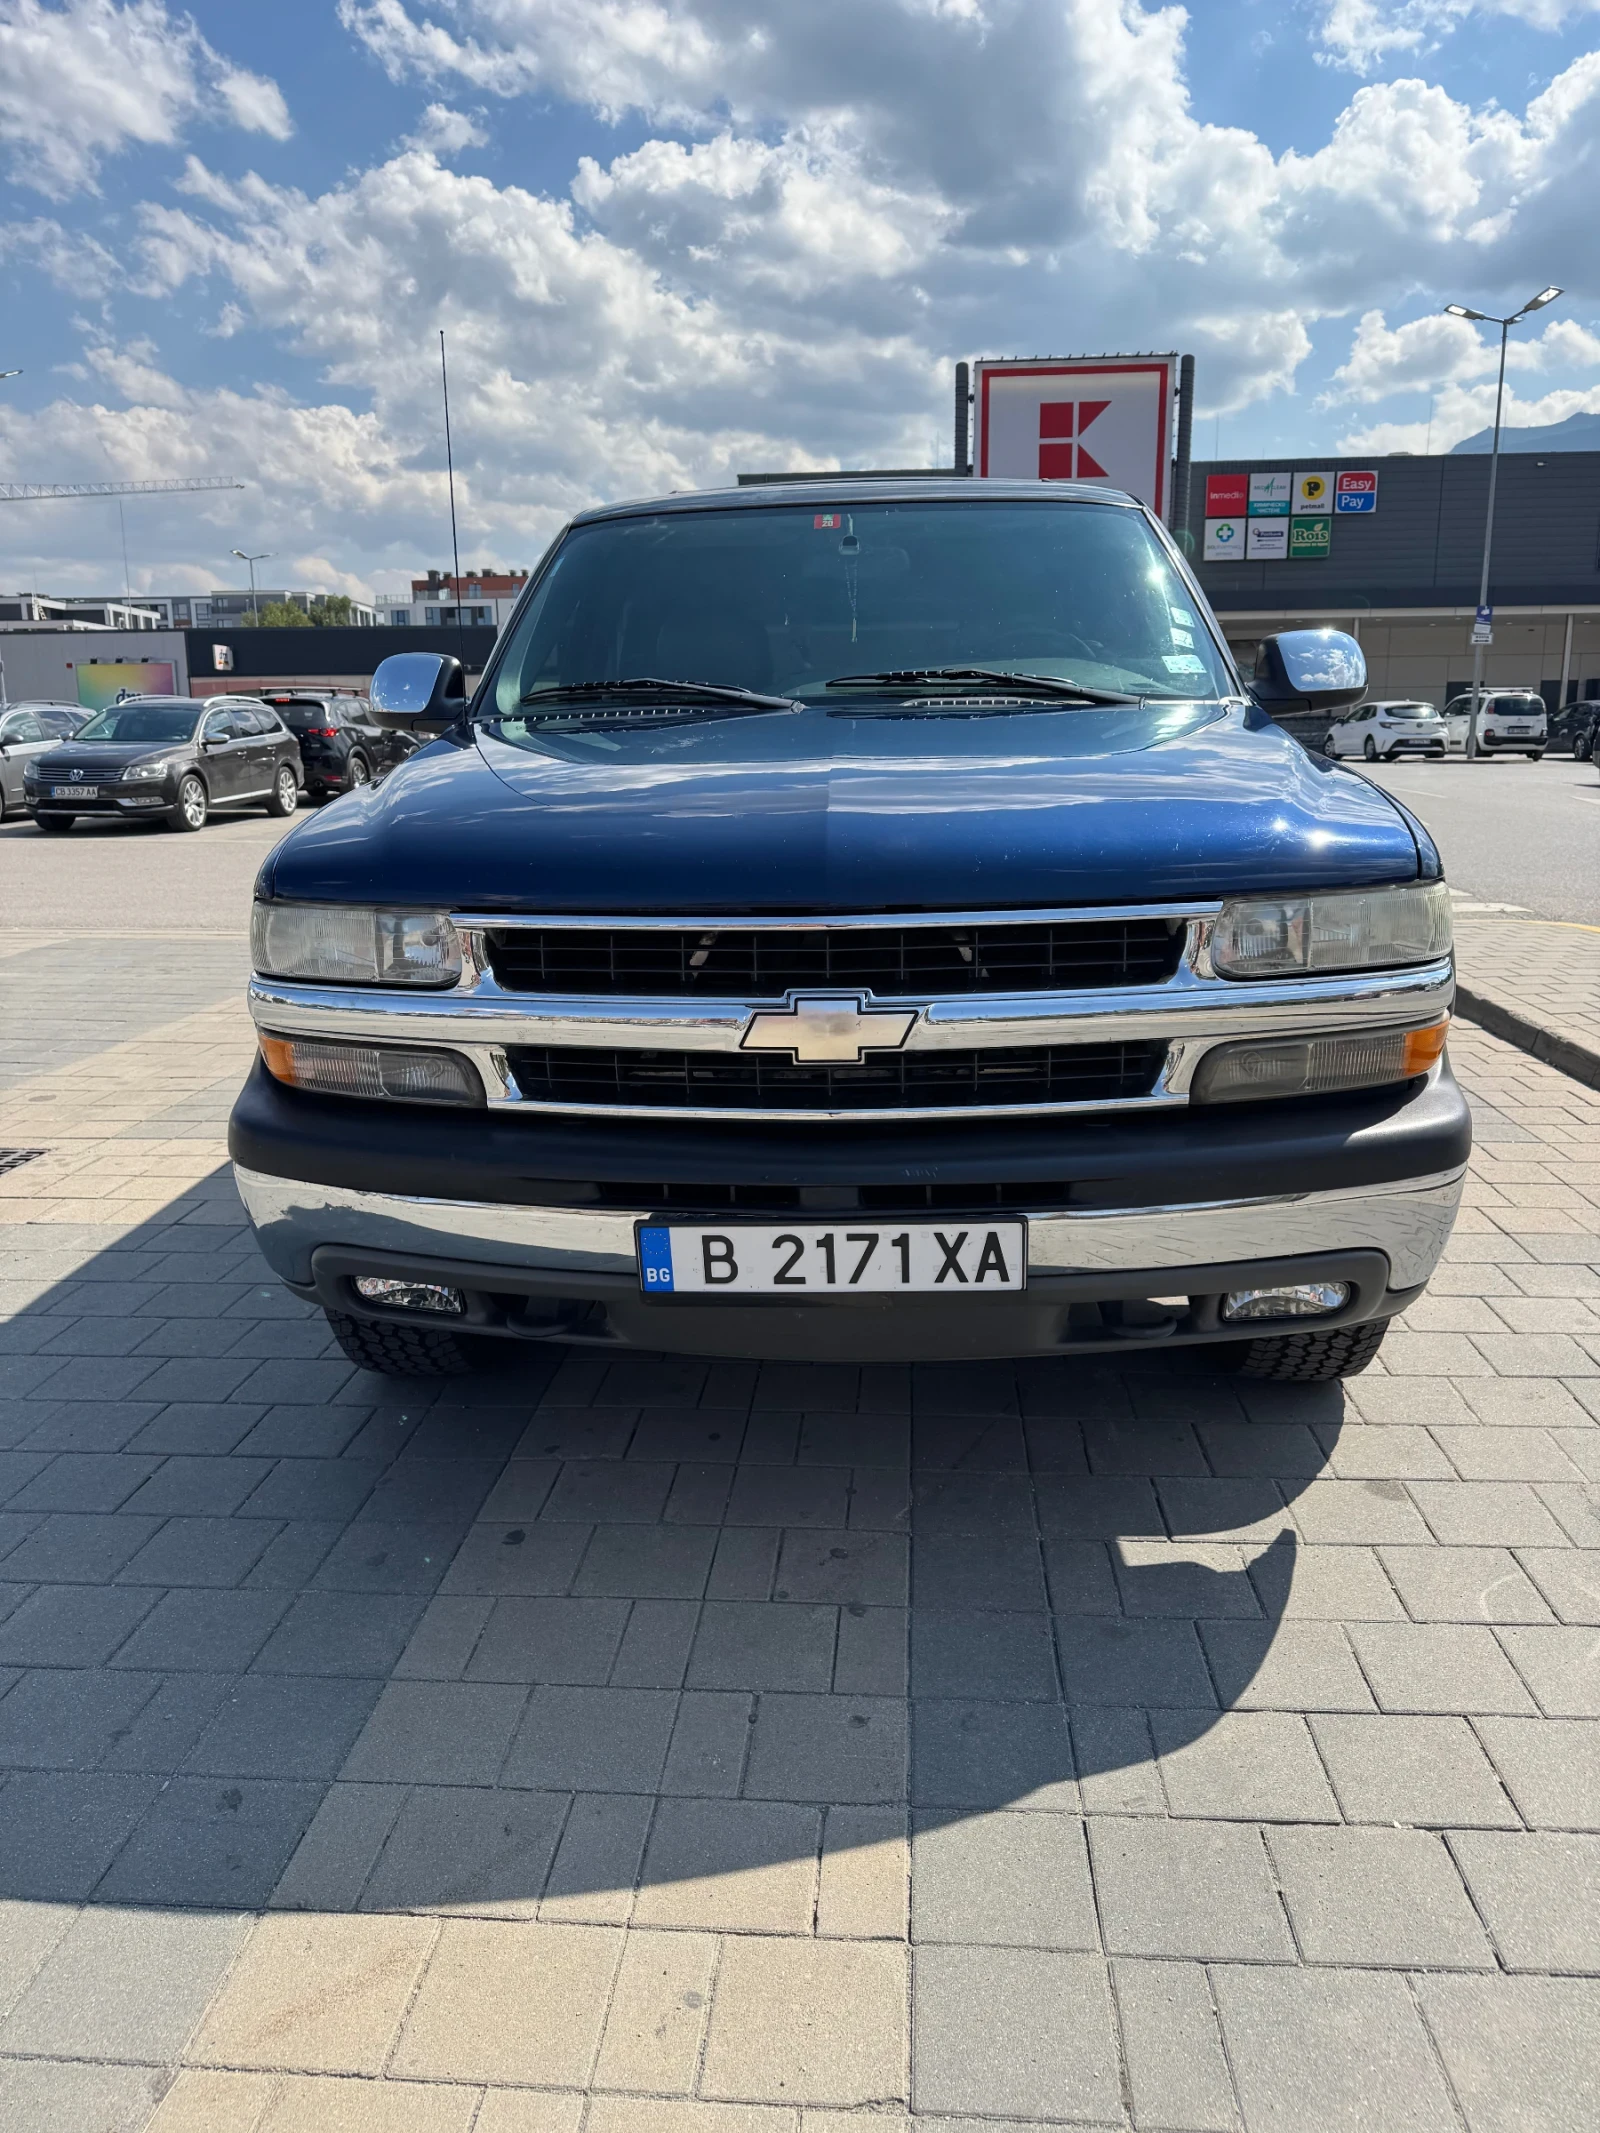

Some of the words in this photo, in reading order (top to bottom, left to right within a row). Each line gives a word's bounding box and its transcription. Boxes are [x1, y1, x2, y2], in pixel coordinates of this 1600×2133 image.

[1038, 400, 1112, 479] K
[1342, 477, 1372, 491] Easy
[1210, 491, 1244, 500] inmedio
[1341, 495, 1365, 509] Pay
[1294, 529, 1328, 542] Rois
[56, 787, 66, 796] CB
[66, 787, 85, 797] 3357
[86, 787, 97, 797] AA
[702, 1234, 739, 1284] B
[772, 1232, 910, 1285] 2171
[933, 1231, 1011, 1283] XA
[646, 1267, 671, 1283] BG
